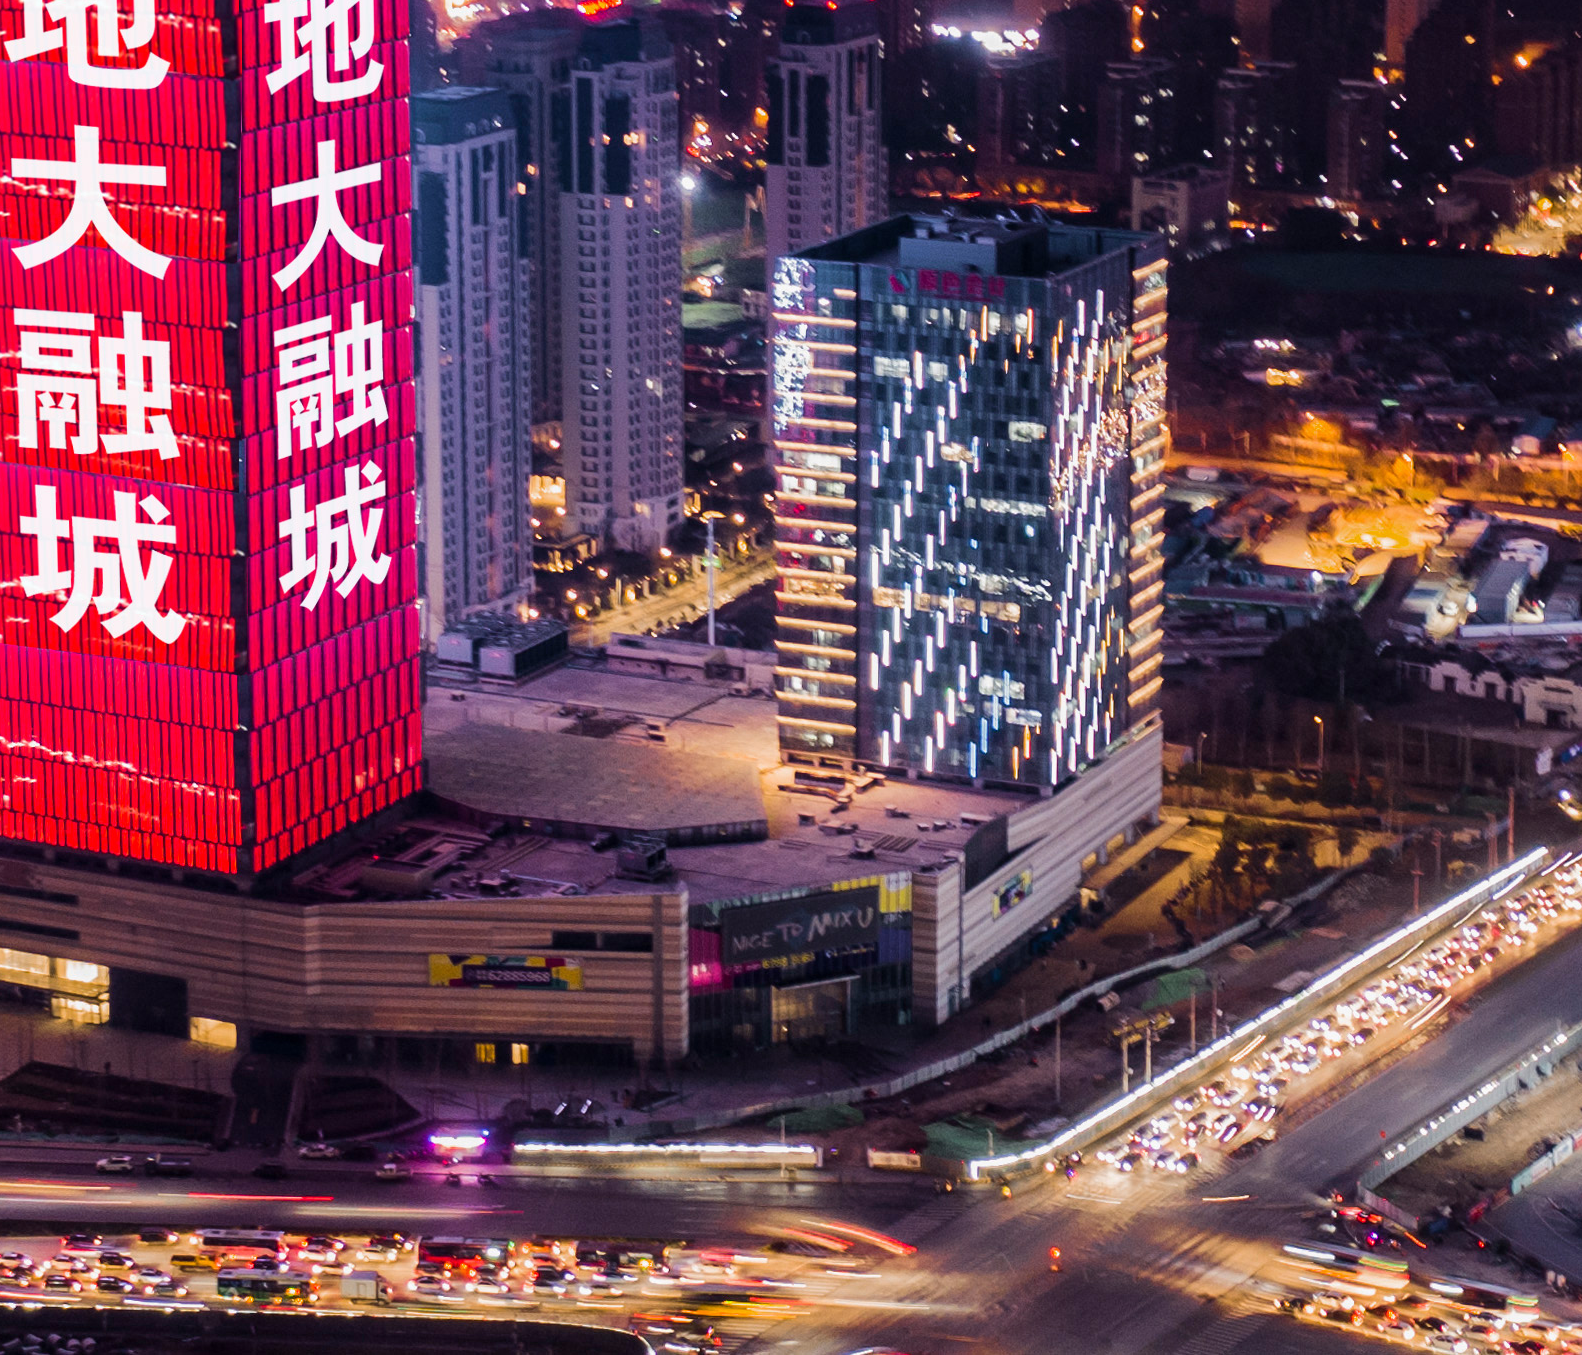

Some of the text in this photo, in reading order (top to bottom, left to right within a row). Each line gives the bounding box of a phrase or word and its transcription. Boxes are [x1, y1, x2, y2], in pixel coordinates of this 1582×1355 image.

[732, 907, 874, 954] NICE TO MIX U
